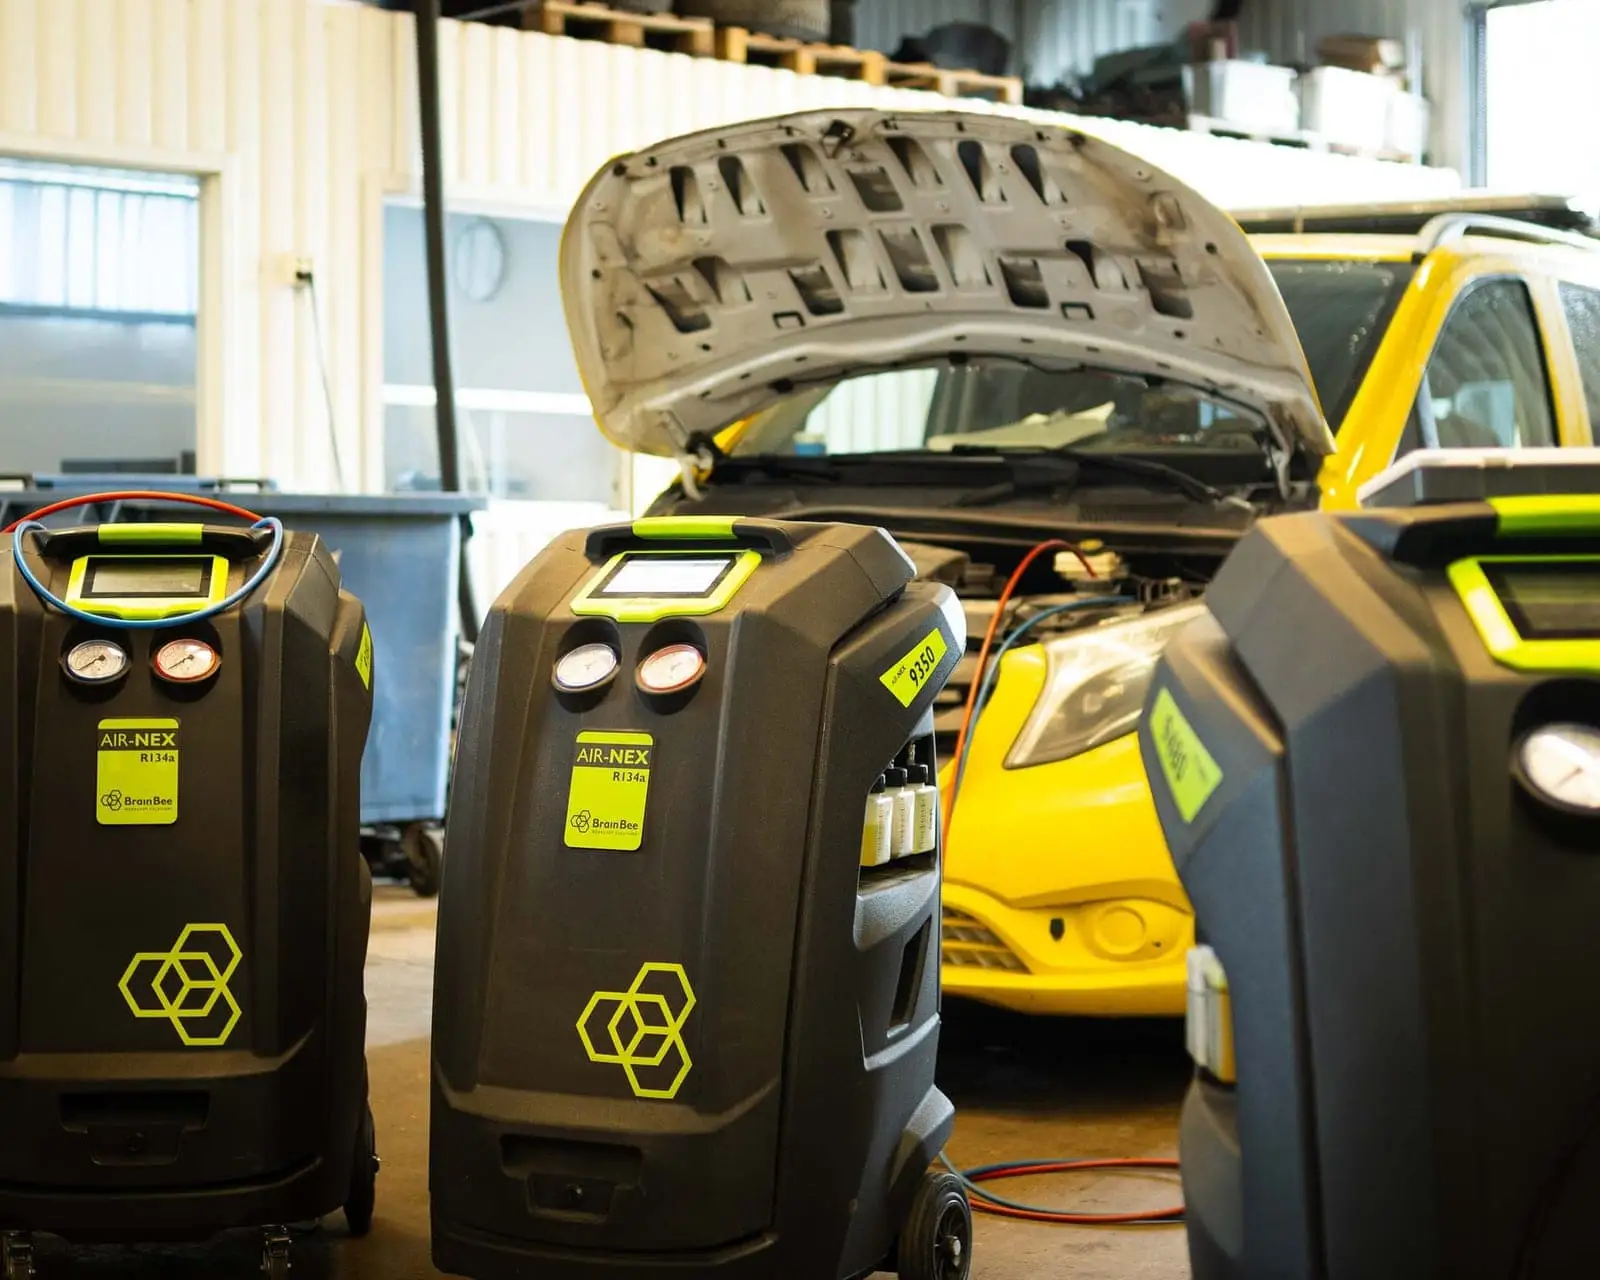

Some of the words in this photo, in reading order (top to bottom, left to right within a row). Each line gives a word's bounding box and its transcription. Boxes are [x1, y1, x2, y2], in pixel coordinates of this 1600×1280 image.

[909, 646, 935, 688] 9350
[100, 733, 176, 747] AIR-NEX
[140, 753, 175, 763] R134a
[576, 748, 649, 765] AIR-NEX
[612, 771, 646, 783] R134a
[124, 796, 173, 806] BrainBee
[592, 818, 639, 830] BrainBee
